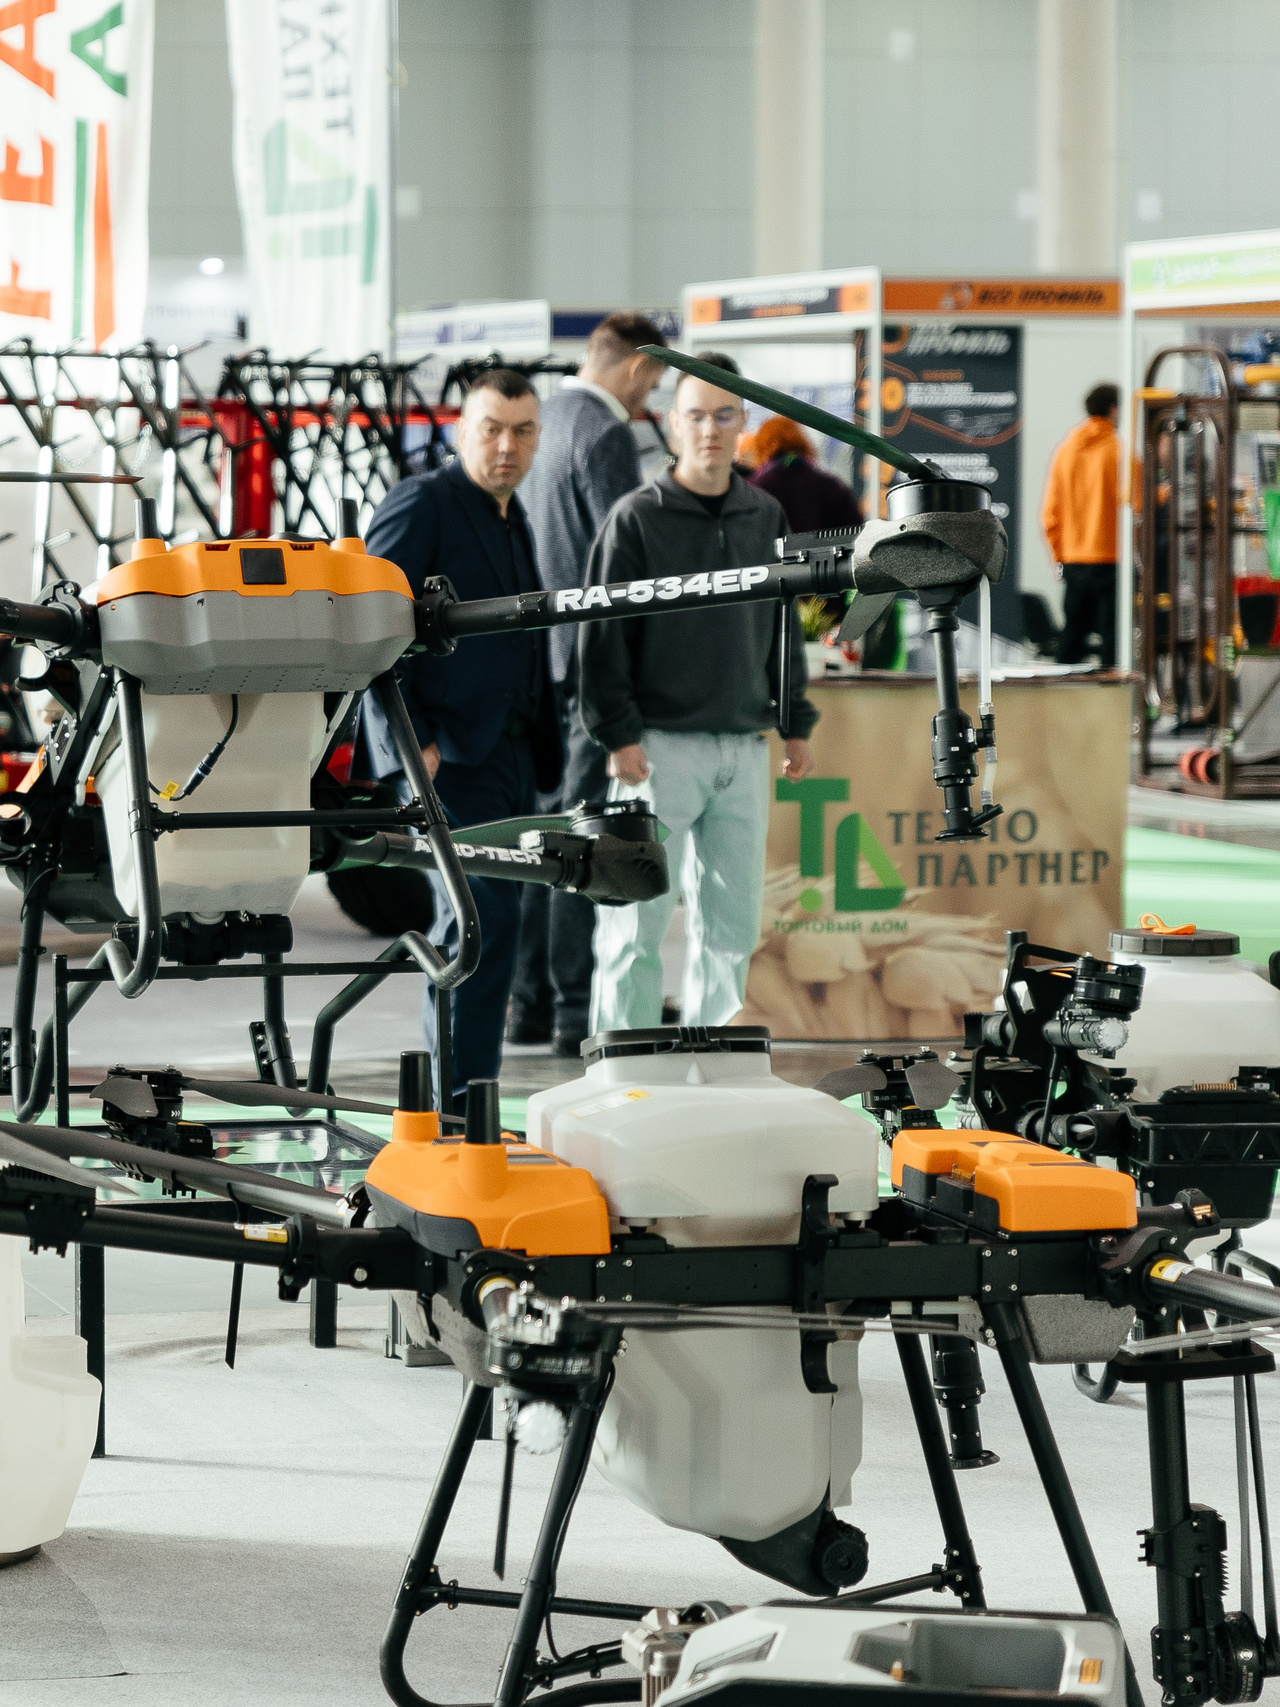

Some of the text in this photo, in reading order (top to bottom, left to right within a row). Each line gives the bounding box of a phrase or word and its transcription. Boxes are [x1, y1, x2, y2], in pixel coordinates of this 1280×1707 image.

[555, 566, 770, 613] RA-534EP
[917, 850, 1110, 888] ПАРТНЕР
[773, 918, 908, 934] ТОРГОВЫЙ ДОМ
